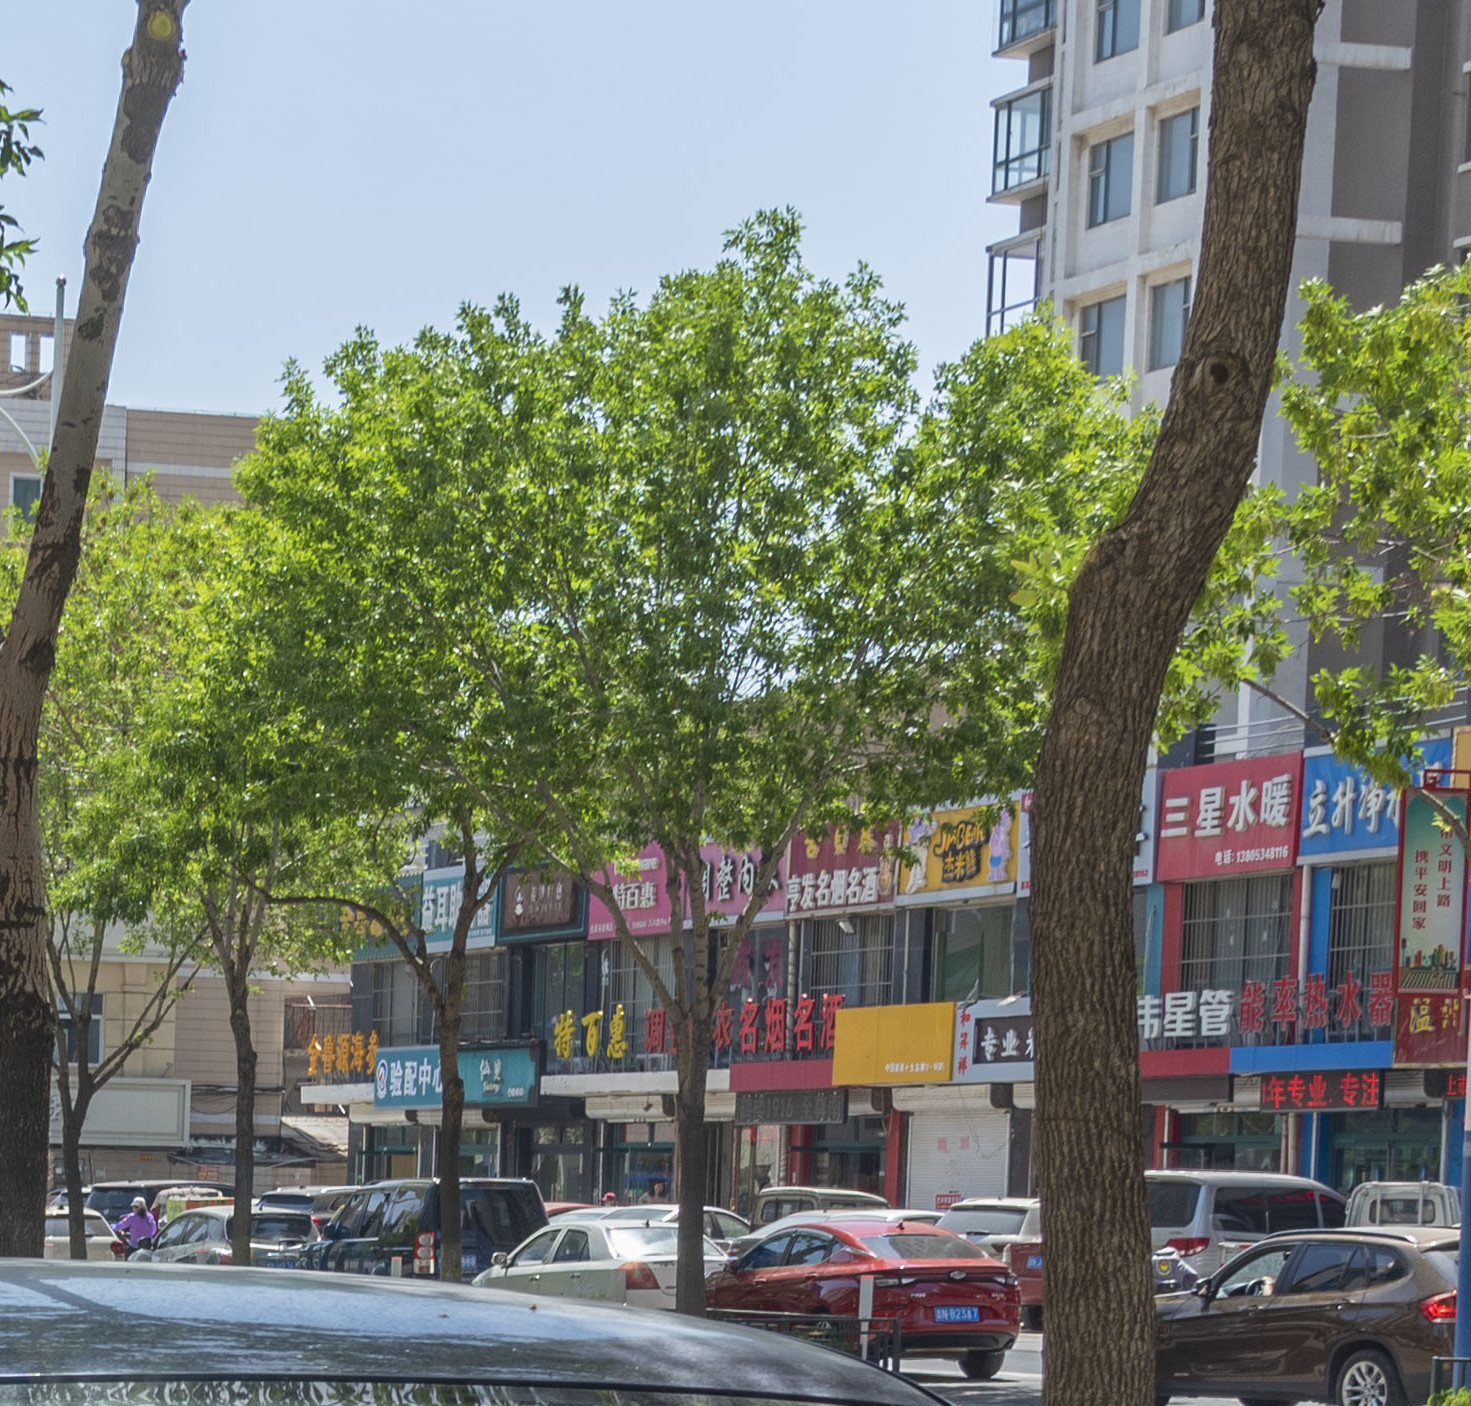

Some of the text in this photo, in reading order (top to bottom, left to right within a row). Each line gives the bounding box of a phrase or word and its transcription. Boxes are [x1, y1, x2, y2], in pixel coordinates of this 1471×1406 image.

[1161, 773, 1293, 838] 三星水暖
[553, 1003, 628, 1060] 特百惠
[1239, 970, 1393, 1034] 能率热水器
